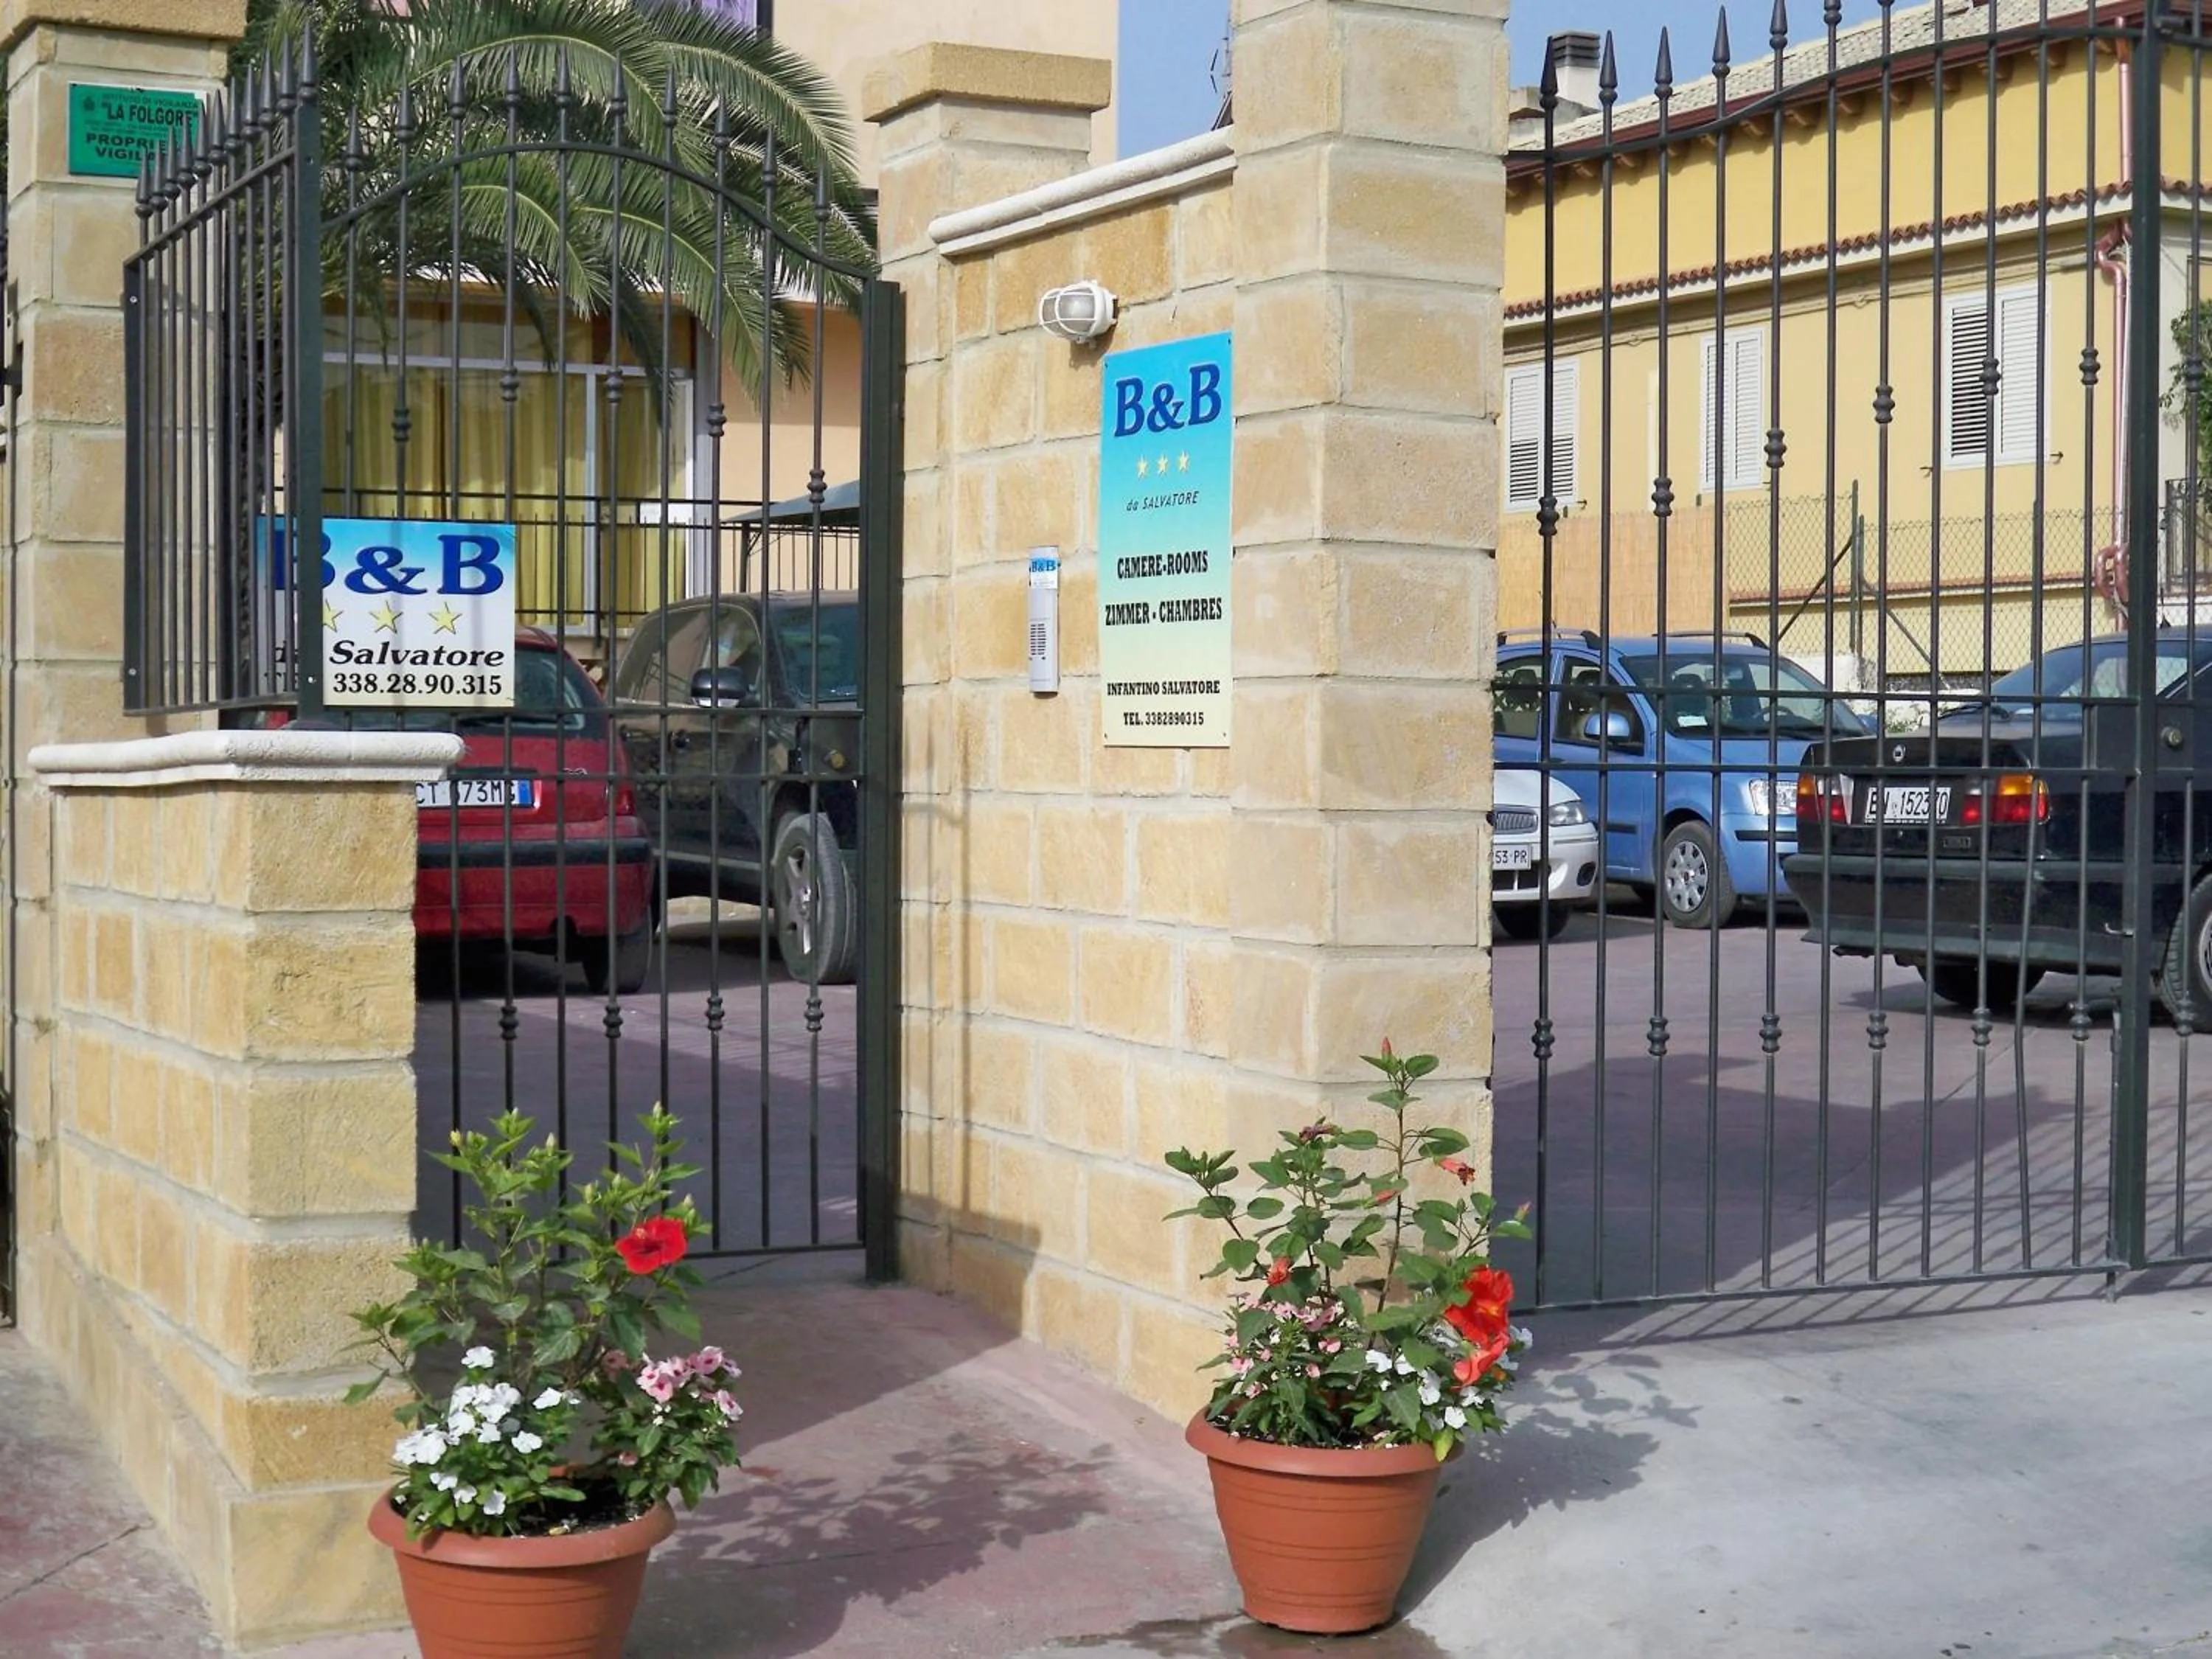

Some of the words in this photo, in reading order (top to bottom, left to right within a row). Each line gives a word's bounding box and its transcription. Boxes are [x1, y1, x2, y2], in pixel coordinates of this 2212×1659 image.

[1114, 364, 1222, 437] B&B
[1126, 499, 1139, 512] da
[1142, 490, 1200, 510] SALVATORE
[1105, 602, 1150, 626] ZIMMER
[1158, 597, 1222, 623] CHAMBRES
[329, 640, 505, 667] Salvatore
[333, 672, 503, 695] 338.28.90.315
[1107, 682, 1160, 696] INFANTINO
[1161, 680, 1221, 695] SALVATORE
[1123, 712, 1144, 726] TEL.
[1145, 712, 1205, 726] 3382890315
